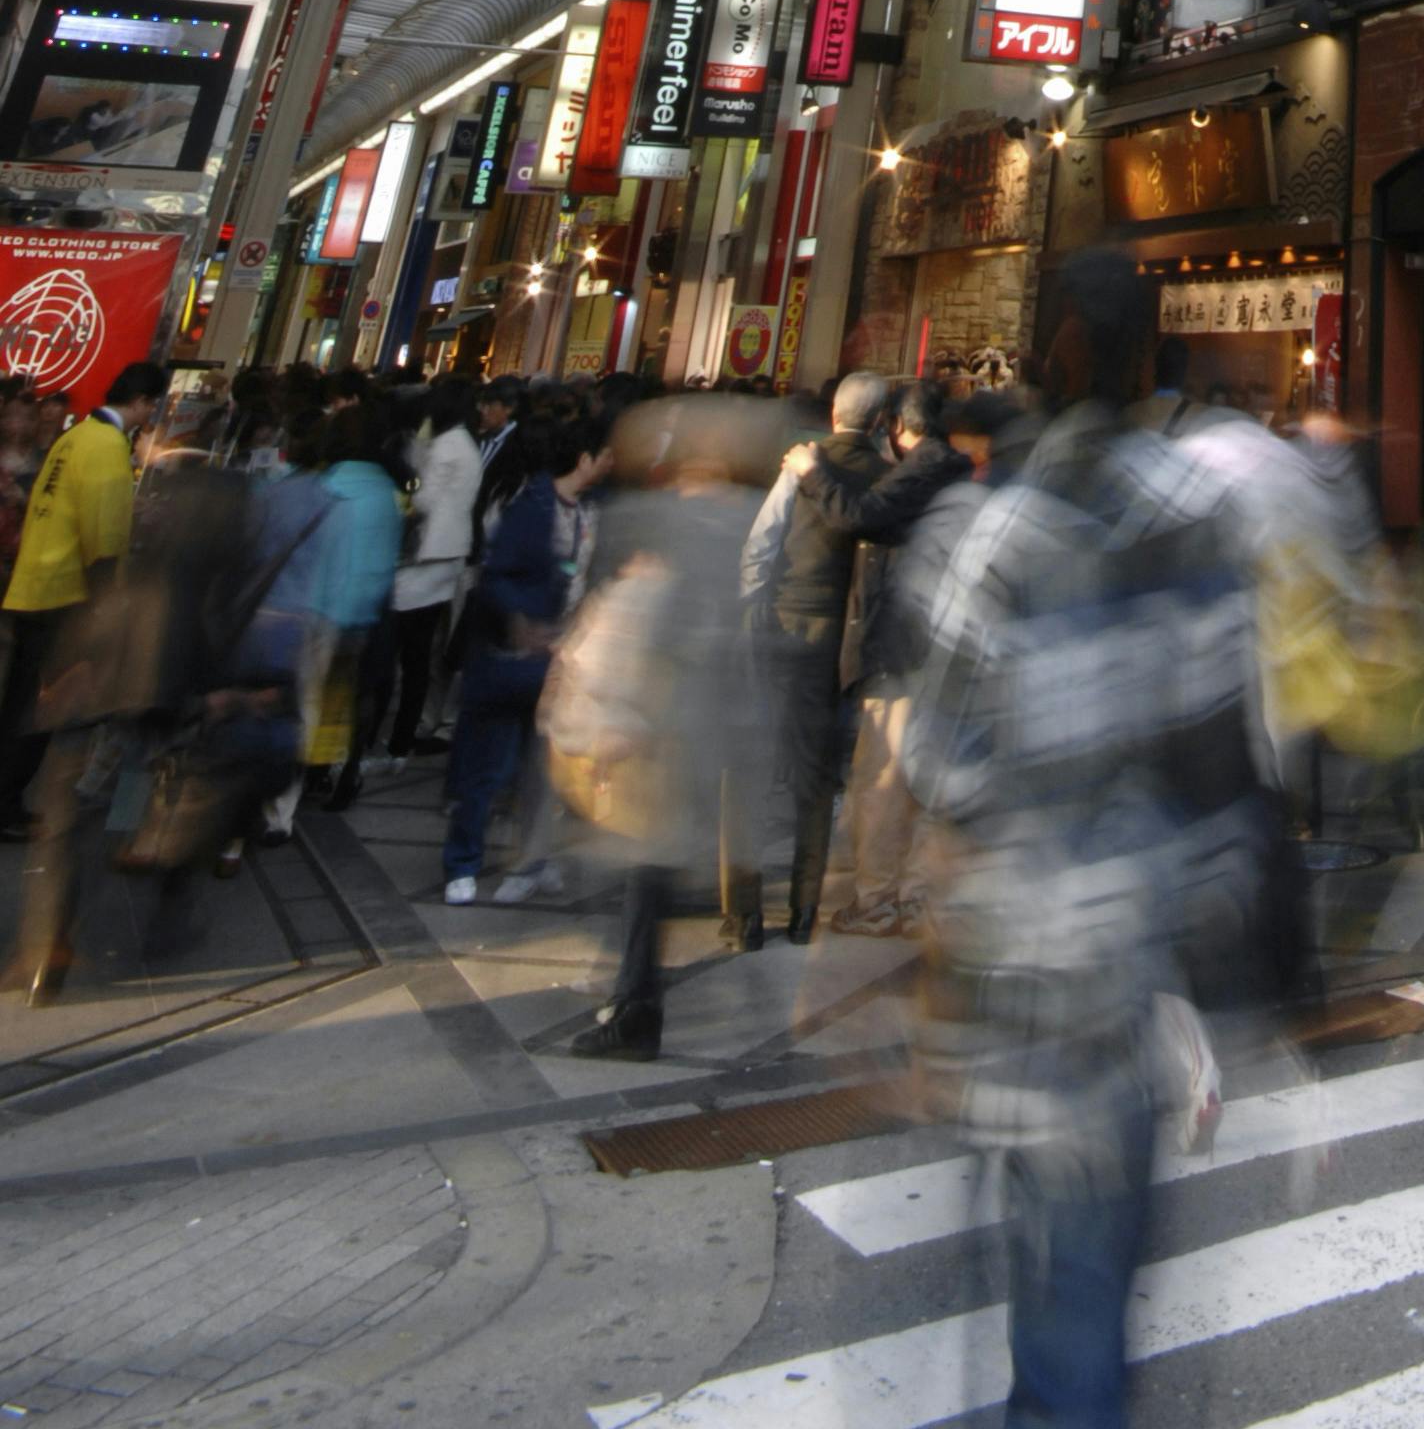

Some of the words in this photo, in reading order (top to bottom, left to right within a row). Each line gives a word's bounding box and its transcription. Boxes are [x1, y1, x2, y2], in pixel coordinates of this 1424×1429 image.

[996, 20, 1076, 56] アイフル
[482, 84, 511, 160] EXCELSIOR
[637, 151, 677, 167] NICE
[28, 236, 106, 249] CLOTHING
[110, 238, 161, 251] STORE
